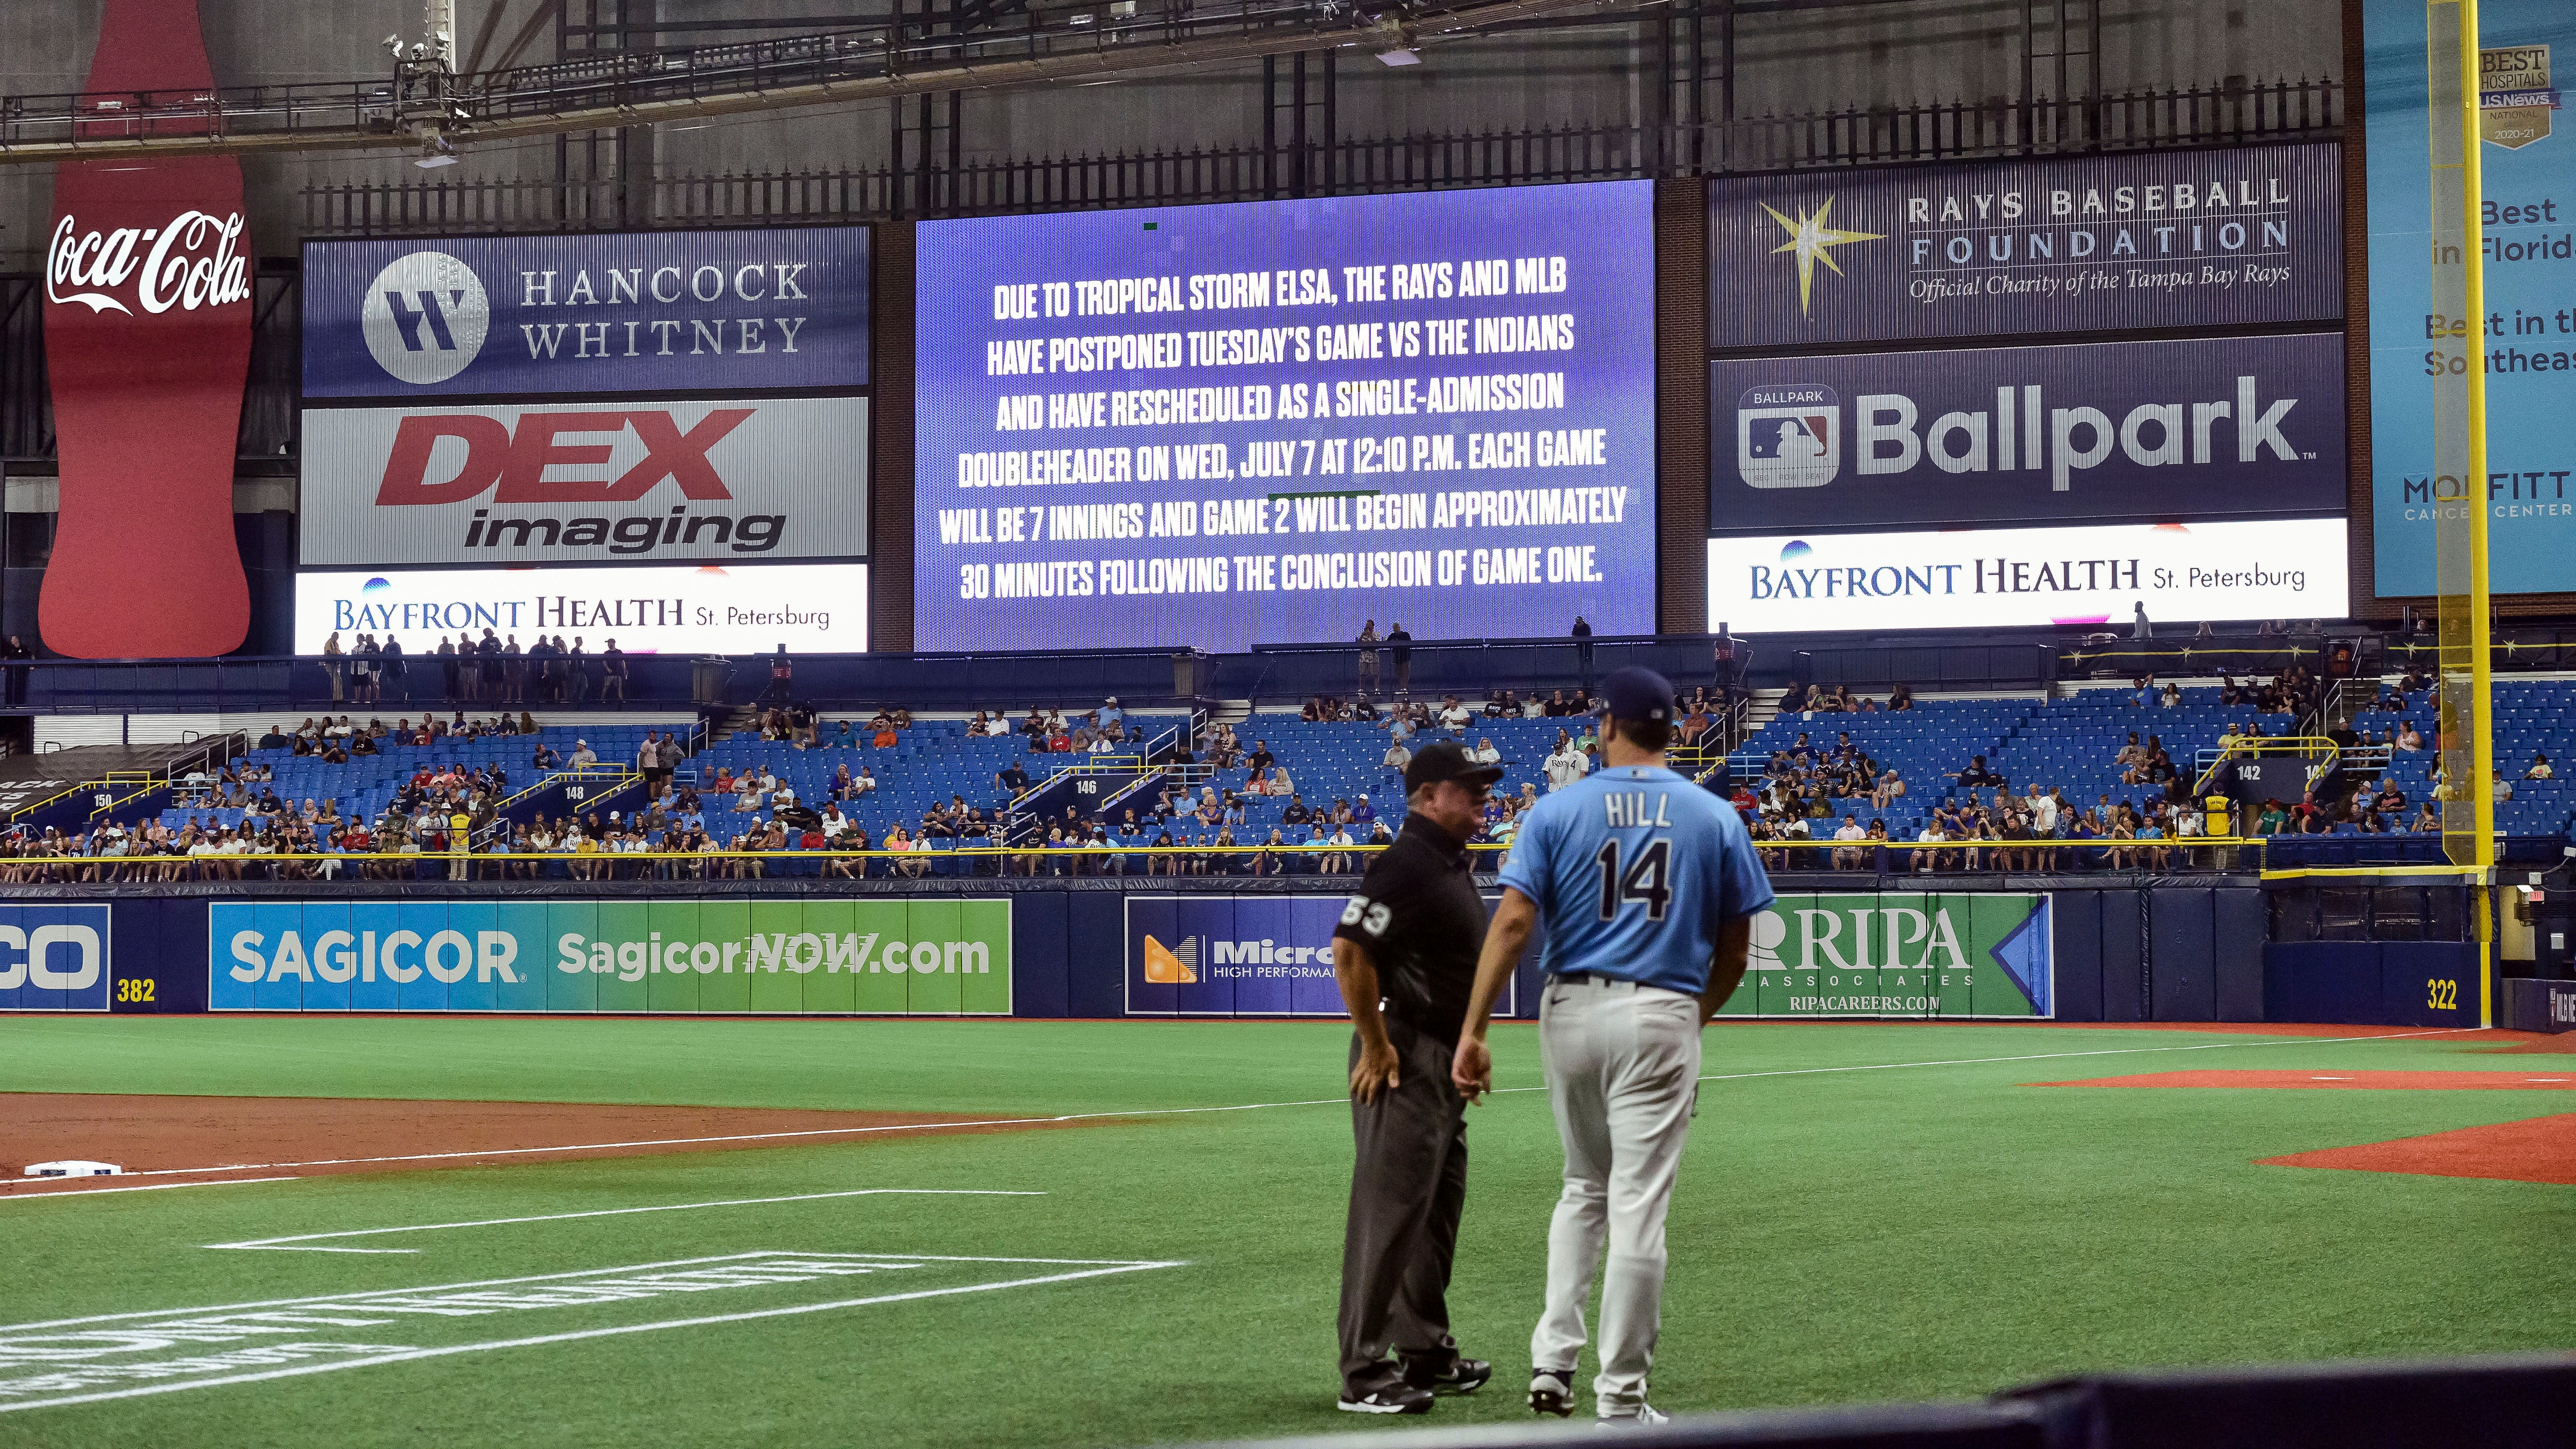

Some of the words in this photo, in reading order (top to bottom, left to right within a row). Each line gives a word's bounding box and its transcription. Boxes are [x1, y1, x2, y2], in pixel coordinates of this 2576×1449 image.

[2481, 49, 2545, 73] BEST
[2481, 72, 2545, 90] HOSPITALS
[2490, 111, 2538, 120] NATIONAL
[2495, 128, 2534, 140] 2020-21
[1908, 192, 2023, 223] RAYS
[2052, 178, 2289, 216] BASEBALL
[2482, 199, 2556, 225] Best
[1911, 220, 2288, 264] FOUNDATION
[2482, 234, 2576, 261] Florid
[521, 264, 807, 305] HANCOCK
[994, 283, 1038, 320] DUE
[1042, 281, 1070, 318] TO
[1075, 275, 1184, 316] TROPICAL
[1189, 272, 1270, 311] STORM
[1276, 267, 1338, 307] ELSA,
[1343, 265, 1386, 303] THE
[1392, 261, 1453, 300] RAYS
[1458, 259, 1508, 296] AND
[1515, 256, 1567, 294] MLB
[1910, 276, 1980, 303] Official
[1987, 274, 2060, 297] Charity
[2067, 271, 2087, 296] of
[2091, 271, 2119, 289] the
[2127, 269, 2193, 292] Tampa
[2199, 266, 2237, 289] Bay
[2243, 264, 2290, 287] Rays
[520, 317, 806, 359] WHITNEY
[2516, 309, 2544, 335] in
[987, 339, 1044, 376] HAVE
[1049, 332, 1182, 373] POSTPONED
[1316, 321, 1383, 361] GAME
[1388, 321, 1420, 358] VS
[1425, 318, 1469, 355] THE
[1475, 314, 1574, 354] INDIANS
[996, 394, 1042, 431] AND
[1048, 391, 1106, 428] HAVE
[1111, 384, 1272, 426] RESCHEDULED
[1278, 383, 1309, 420] AS
[1313, 382, 1331, 418] A
[1335, 372, 1564, 417] SINGLE-ADMISSION
[1754, 391, 1823, 404] BALLPARK
[1856, 376, 2300, 491] Ballpark
[375, 409, 757, 505] DEX
[958, 446, 1132, 488] DOUBLEHEADER
[1136, 445, 1169, 482] ON
[1175, 443, 1235, 482] WED,
[1240, 439, 1296, 477] JULY
[1301, 439, 1316, 476] 7
[1320, 438, 1348, 475] AT
[1353, 435, 1406, 474] 12:10
[1412, 434, 1462, 471] P.M.
[1468, 431, 1530, 469] EACH
[1536, 428, 1606, 467] GAME
[938, 508, 993, 544] WILL
[997, 507, 1025, 542] BE
[1030, 506, 1045, 542] 7
[1049, 502, 1144, 541] INNINGS
[1149, 501, 1197, 538] AND
[1202, 499, 1269, 536] GAME
[1275, 498, 1289, 533] 2
[1295, 496, 1351, 533] WILL
[1356, 493, 1427, 530] BEGIN
[1432, 485, 1628, 529] APPROXIMATELY
[2494, 504, 2572, 518] CENTER
[464, 505, 787, 554] imaging
[960, 564, 989, 599] 30
[995, 560, 1094, 599] MINUTES
[1100, 556, 1228, 595] FOLLOWING
[1233, 556, 1276, 592] THE
[1281, 551, 1432, 590] CONCLUSION
[1437, 550, 1468, 586] OF
[1473, 547, 1542, 585] GAME
[1547, 545, 1603, 584] ONE.
[1750, 564, 1962, 600] BAYFRONT
[1973, 558, 2141, 594] HEALTH
[2153, 569, 2179, 590] St.
[2188, 562, 2306, 591] Petersburg
[333, 599, 526, 630] BAYFRONT
[536, 596, 683, 628] HEALTH
[696, 606, 719, 626] St.
[727, 603, 830, 631] Petersburg
[1570, 760, 1576, 770] 4
[2237, 765, 2260, 781] 142
[94, 794, 112, 807] 150
[565, 786, 584, 799] 148
[1076, 781, 1097, 795] 146
[1604, 792, 1673, 829] HILL
[1596, 838, 1673, 923] 14
[1341, 894, 1392, 937] 53
[229, 929, 519, 984] SAGICOR
[557, 931, 989, 982] SagicorNOW.com
[1793, 907, 1973, 970] RIPA
[1214, 966, 1251, 978] HIGH
[1257, 966, 1336, 978] PERFORMA
[1760, 975, 1973, 987] ASSOCIATES
[117, 979, 155, 1002] 382
[1790, 995, 1940, 1013] RIPACAREERS.COM
[2427, 979, 2457, 1010] 322
[2557, 994, 2568, 1022] MLB
